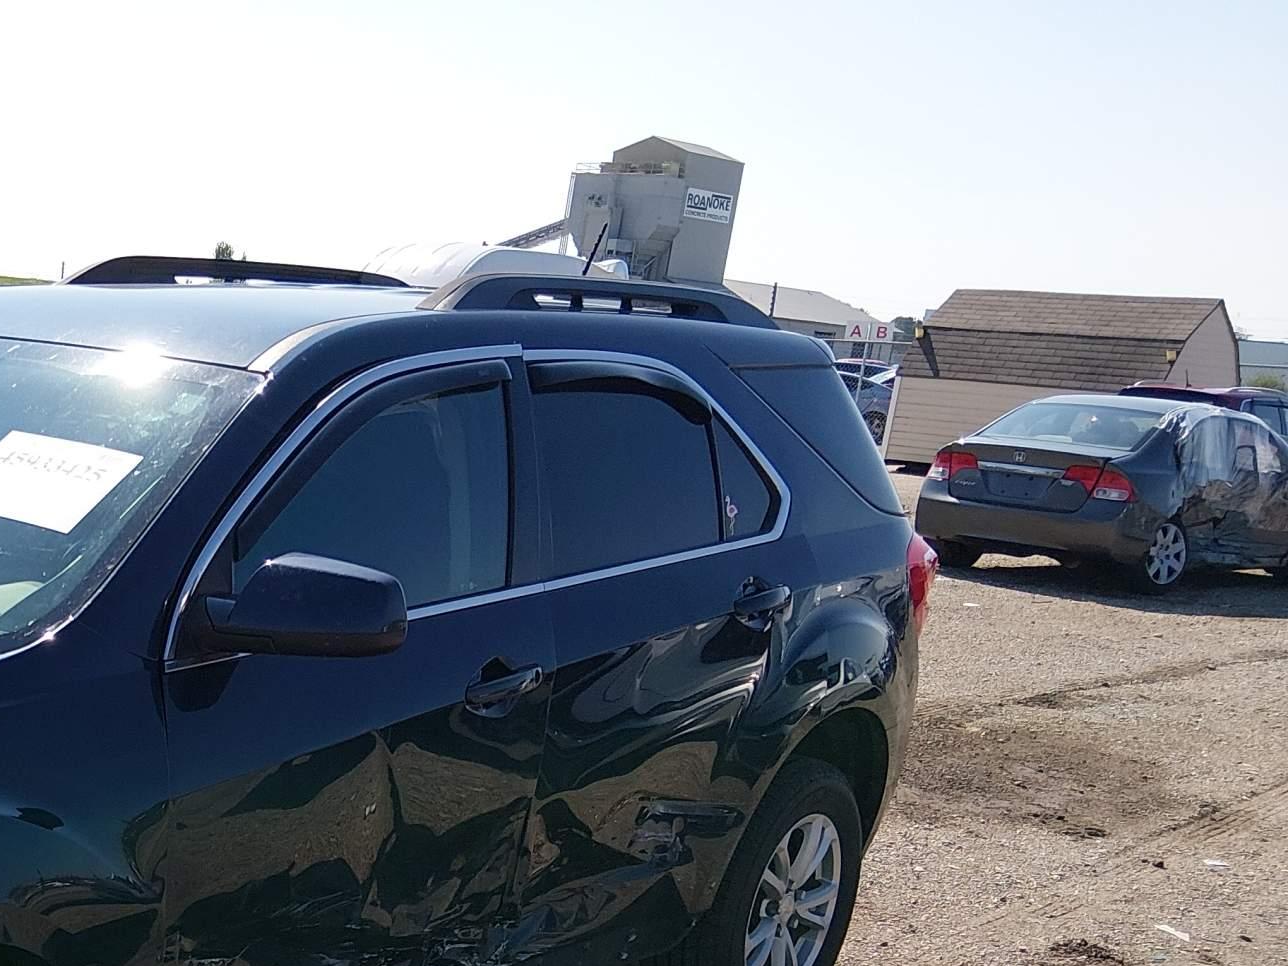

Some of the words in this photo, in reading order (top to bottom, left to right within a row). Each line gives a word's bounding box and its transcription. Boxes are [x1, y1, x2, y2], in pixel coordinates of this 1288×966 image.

[687, 193, 731, 211] ROANOKE
[850, 325, 862, 338] A
[876, 326, 887, 338] B
